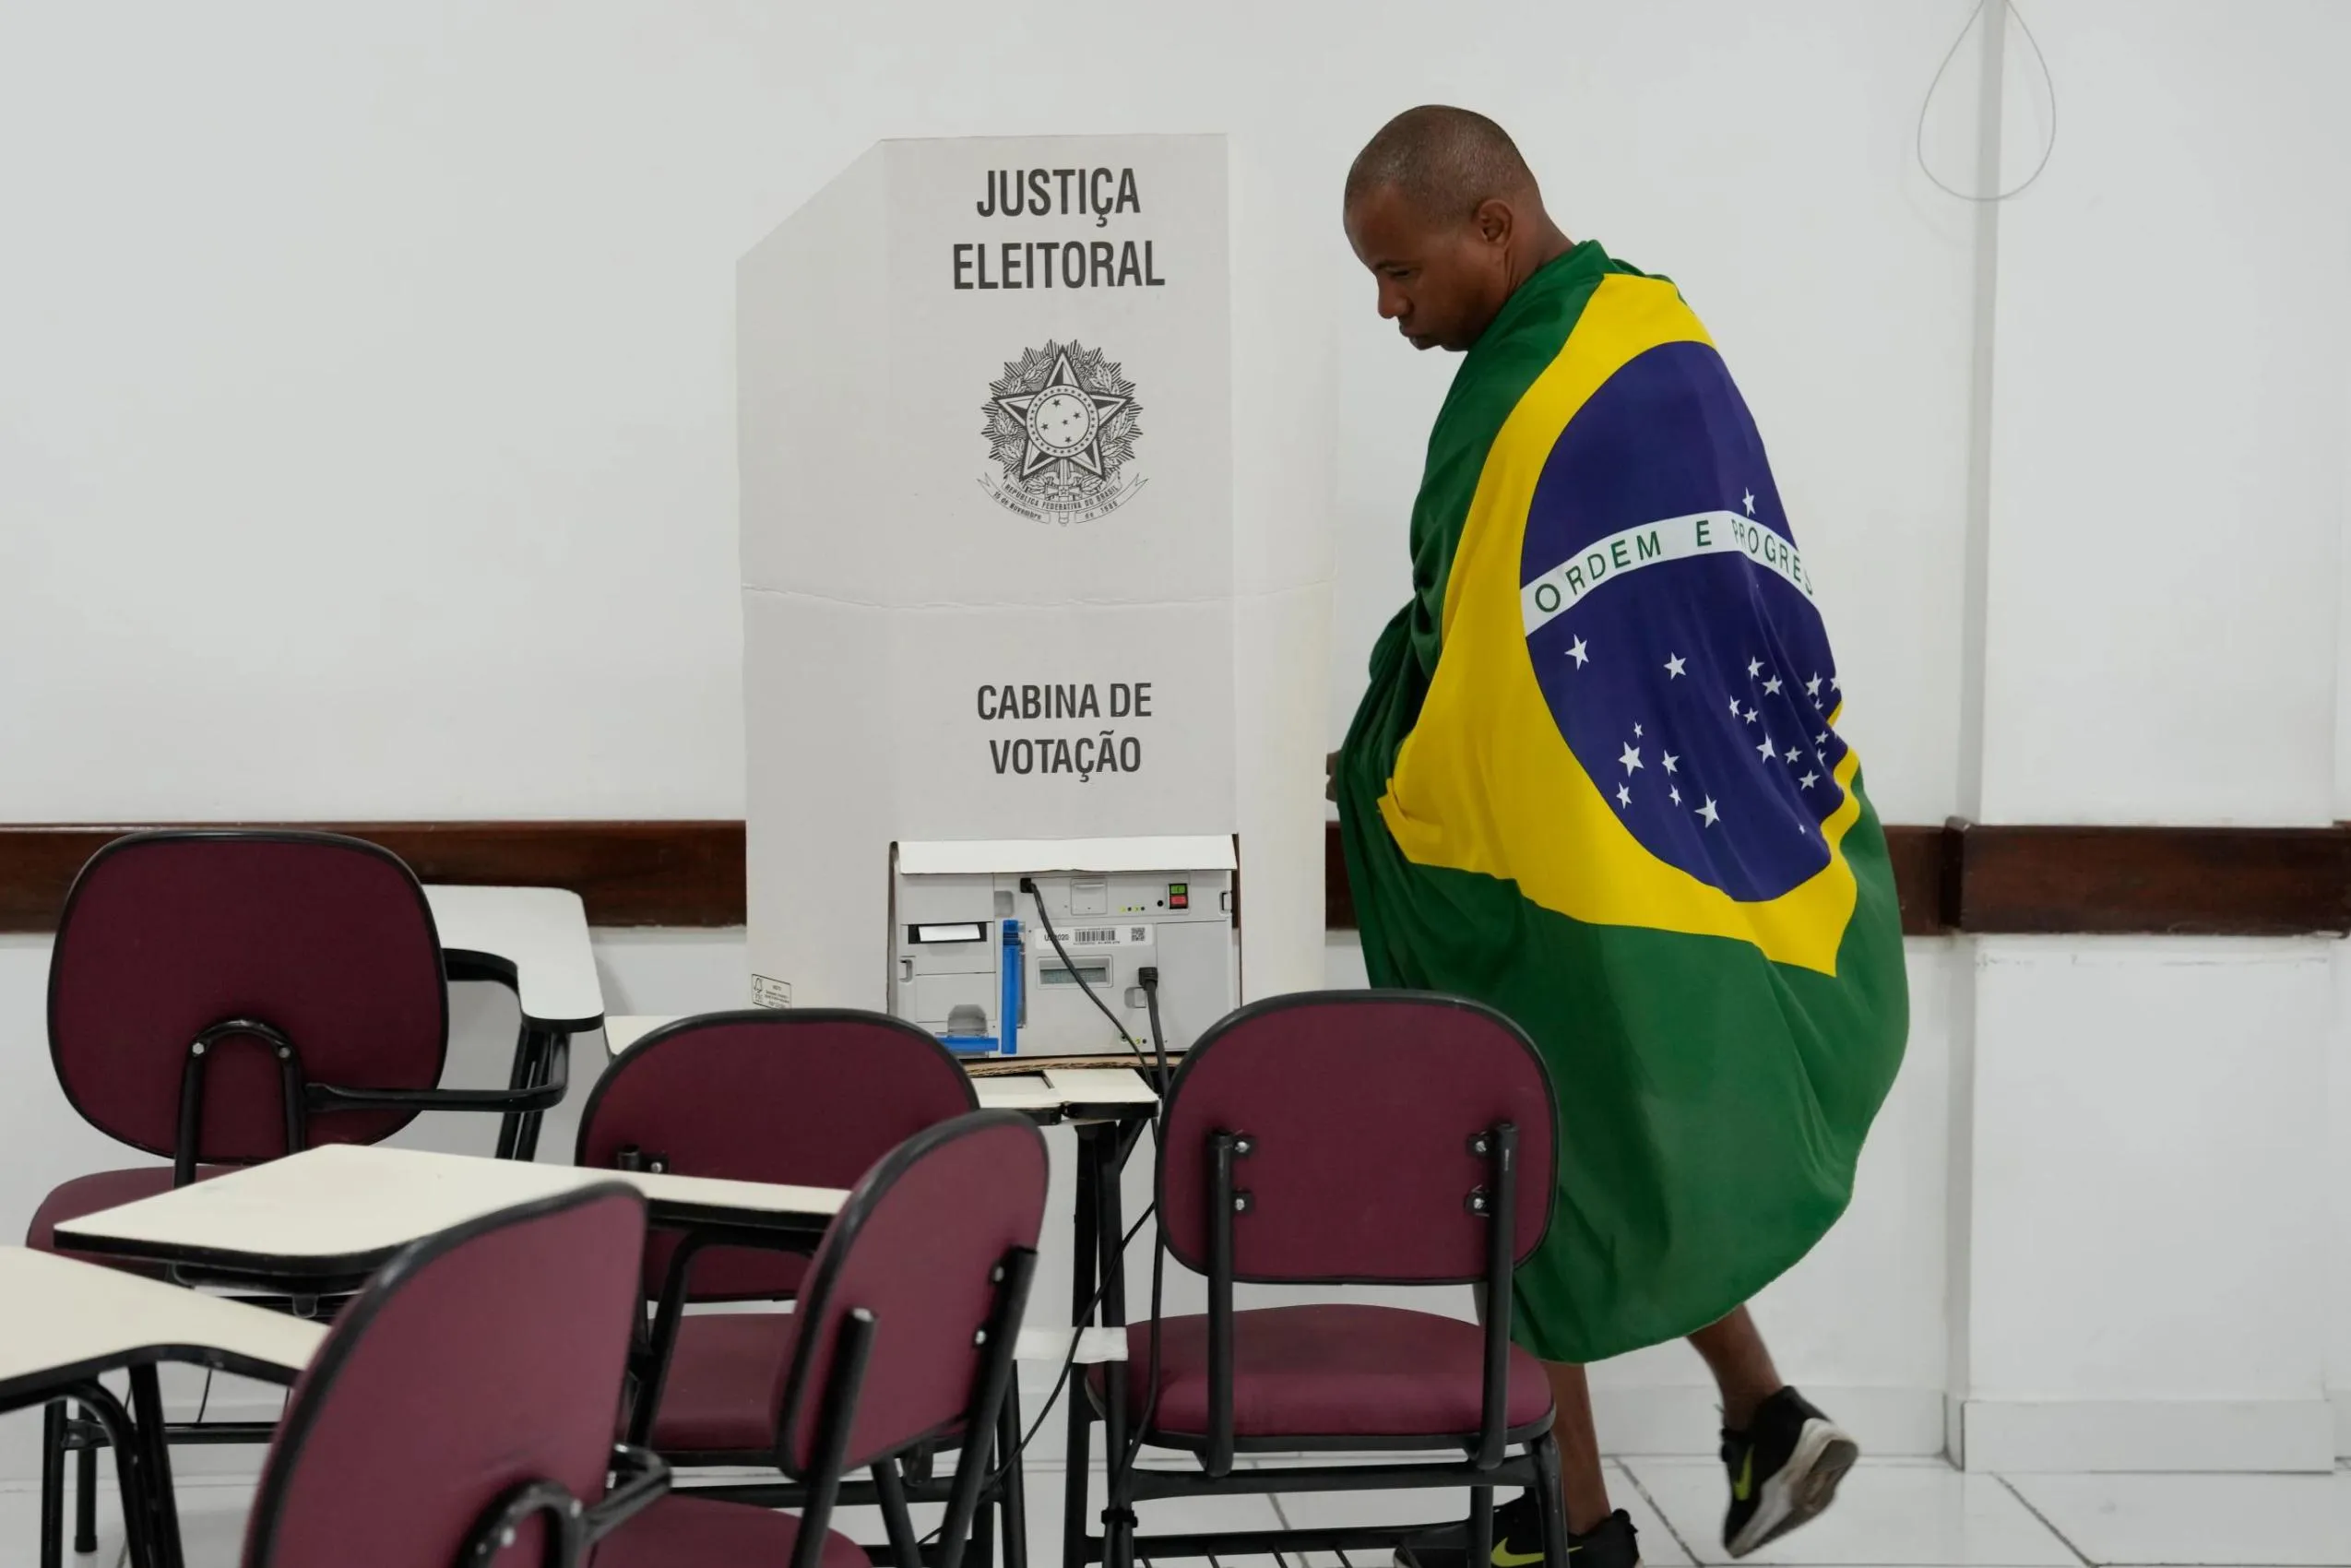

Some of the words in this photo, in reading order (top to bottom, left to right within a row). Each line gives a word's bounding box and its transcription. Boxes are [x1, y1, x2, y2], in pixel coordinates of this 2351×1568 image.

[976, 167, 1141, 229] JUSTIÇA
[953, 240, 1166, 290] ELEITORAL
[1042, 501, 1082, 511] FEDERATIVA
[1096, 485, 1119, 502] BRASIL
[1534, 530, 1662, 613] ORDEM
[1695, 519, 1713, 547] E
[977, 683, 1100, 720] CABINA
[1110, 682, 1152, 718] DE
[989, 730, 1141, 783] VOTAÇÃO
